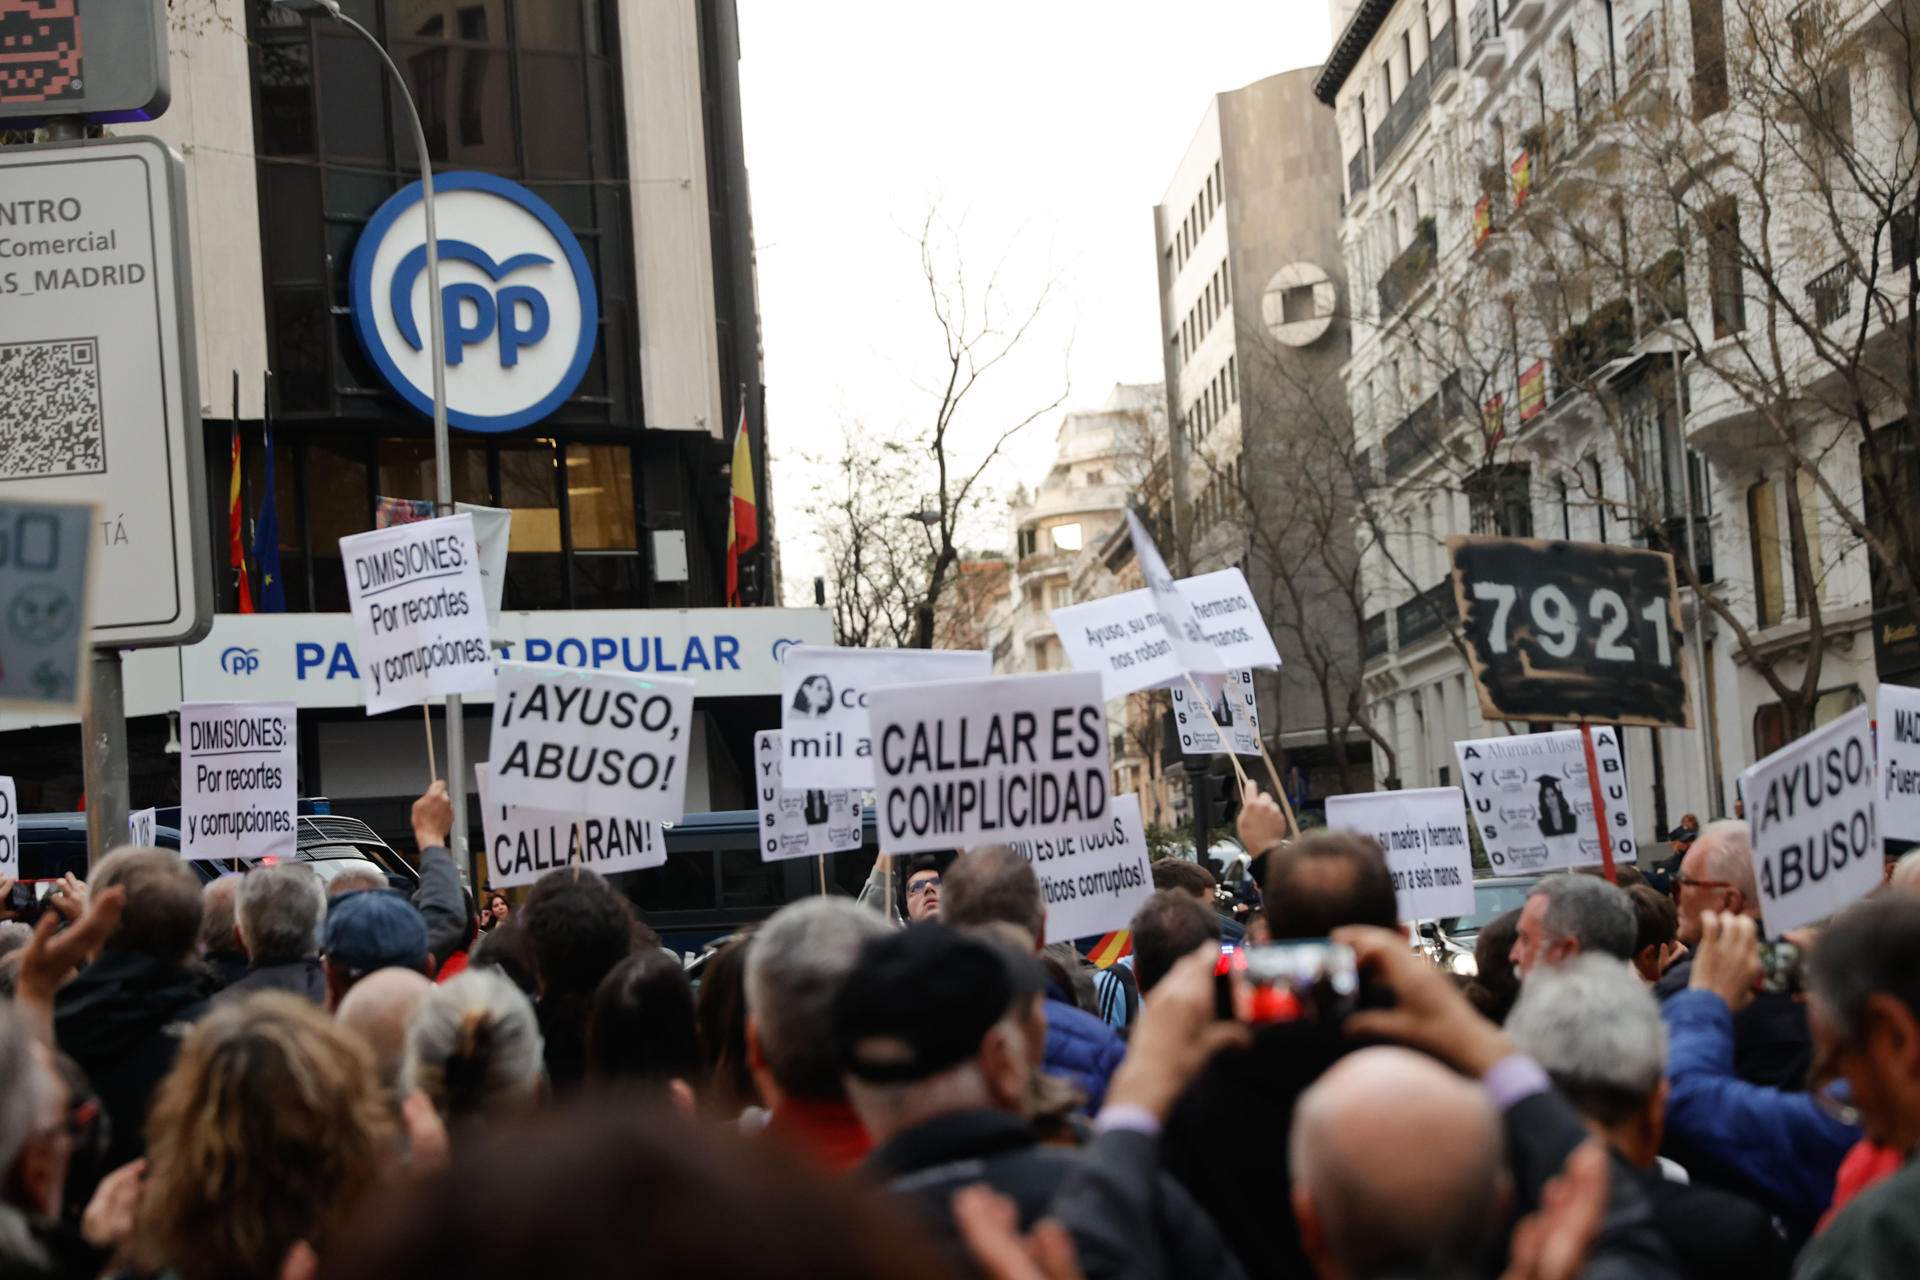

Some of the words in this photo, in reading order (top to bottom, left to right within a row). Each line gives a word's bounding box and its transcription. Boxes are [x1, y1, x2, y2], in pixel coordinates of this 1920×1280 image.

[0, 229, 116, 258] Comercial
[0, 263, 145, 296] S_MADRID
[355, 535, 468, 591] DIMISIONES:
[370, 603, 400, 636] Por
[402, 586, 470, 627] recortes
[1472, 580, 1673, 667] 7921
[370, 659, 382, 696] y
[384, 634, 491, 684] corrupciones.
[525, 635, 742, 673] POPULAR
[1110, 651, 1136, 671] nos
[1136, 637, 1173, 663] roban
[189, 717, 287, 751] DIMISIONES:
[502, 683, 680, 742] ¡AYUSO,
[790, 732, 842, 758] mil
[882, 710, 1037, 776] CALLAR
[1051, 704, 1101, 761] ES
[197, 763, 222, 794] Por
[225, 761, 282, 792] recortes
[499, 740, 676, 792] ABUSO!
[887, 768, 1107, 840] COMPLICIDAD
[1751, 735, 1871, 848] ¡AYUSO,
[188, 814, 198, 844] y
[201, 803, 294, 840] corrupciones.
[495, 816, 652, 877] CALLARAN!
[1391, 821, 1421, 851] madre
[1760, 801, 1876, 900] ABUSO!
[1078, 856, 1147, 899] corruptos!
[1407, 869, 1415, 889] a
[1415, 861, 1433, 889] seis
